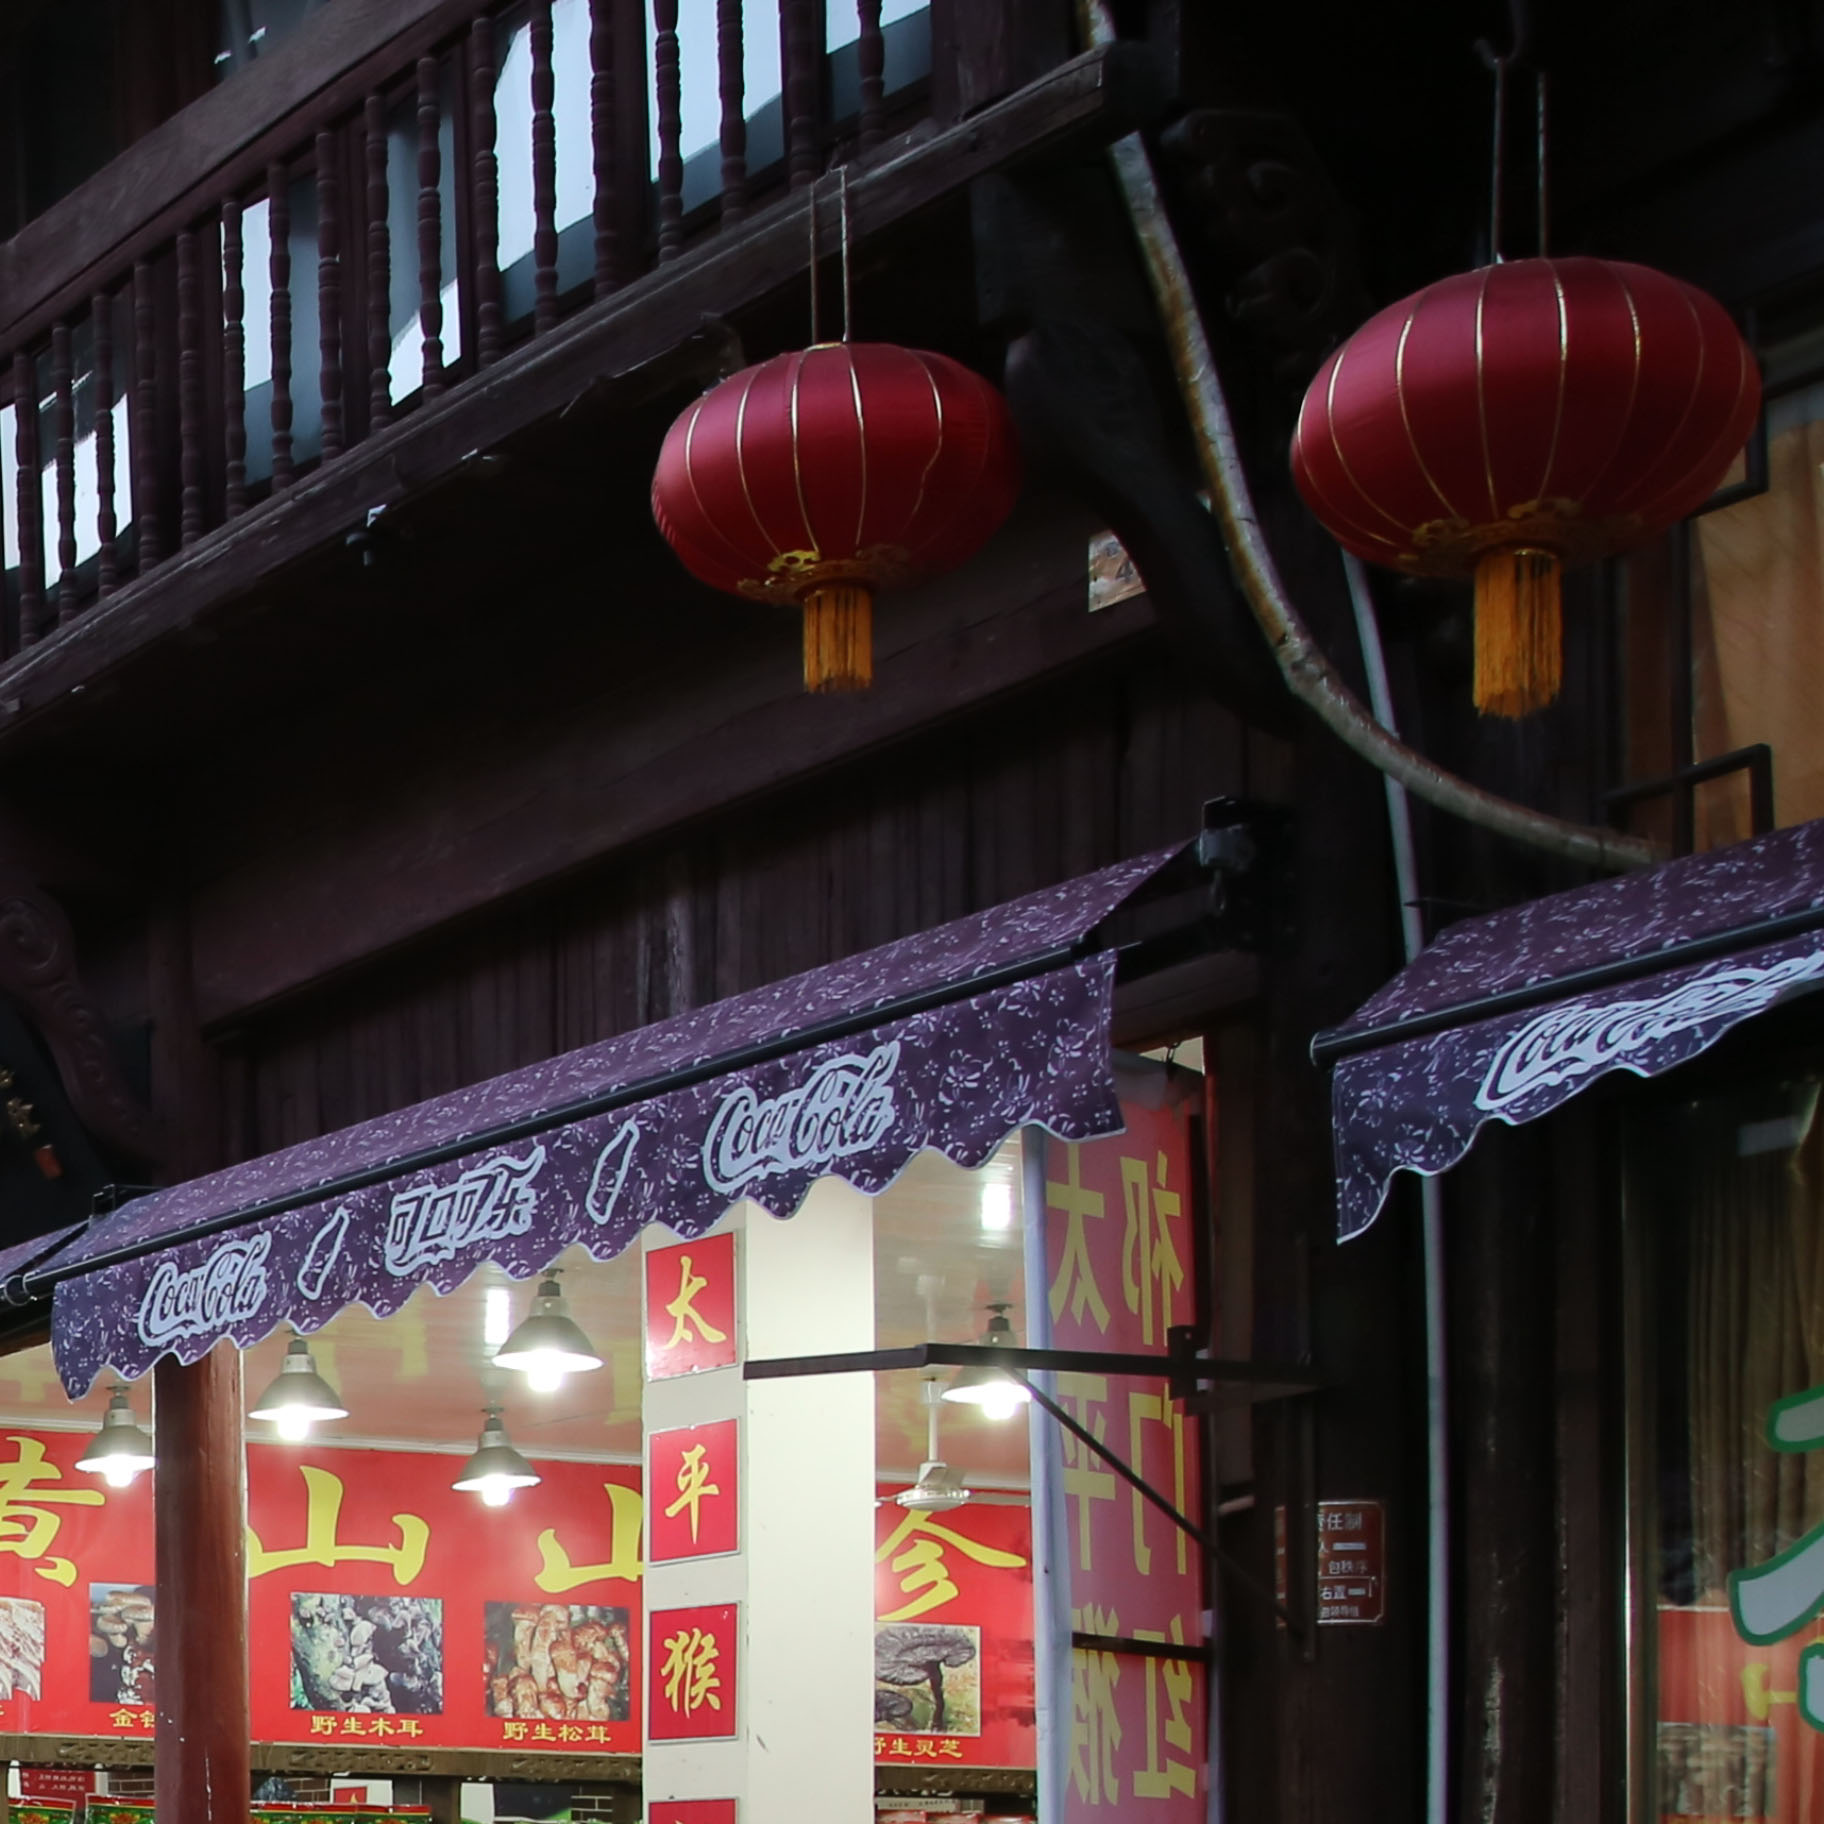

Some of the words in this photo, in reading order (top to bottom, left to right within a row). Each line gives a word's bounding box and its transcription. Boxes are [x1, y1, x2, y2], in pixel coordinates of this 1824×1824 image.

[310, 1715, 424, 1739] 野生木耳
[503, 1722, 612, 1744] 野生松茸
